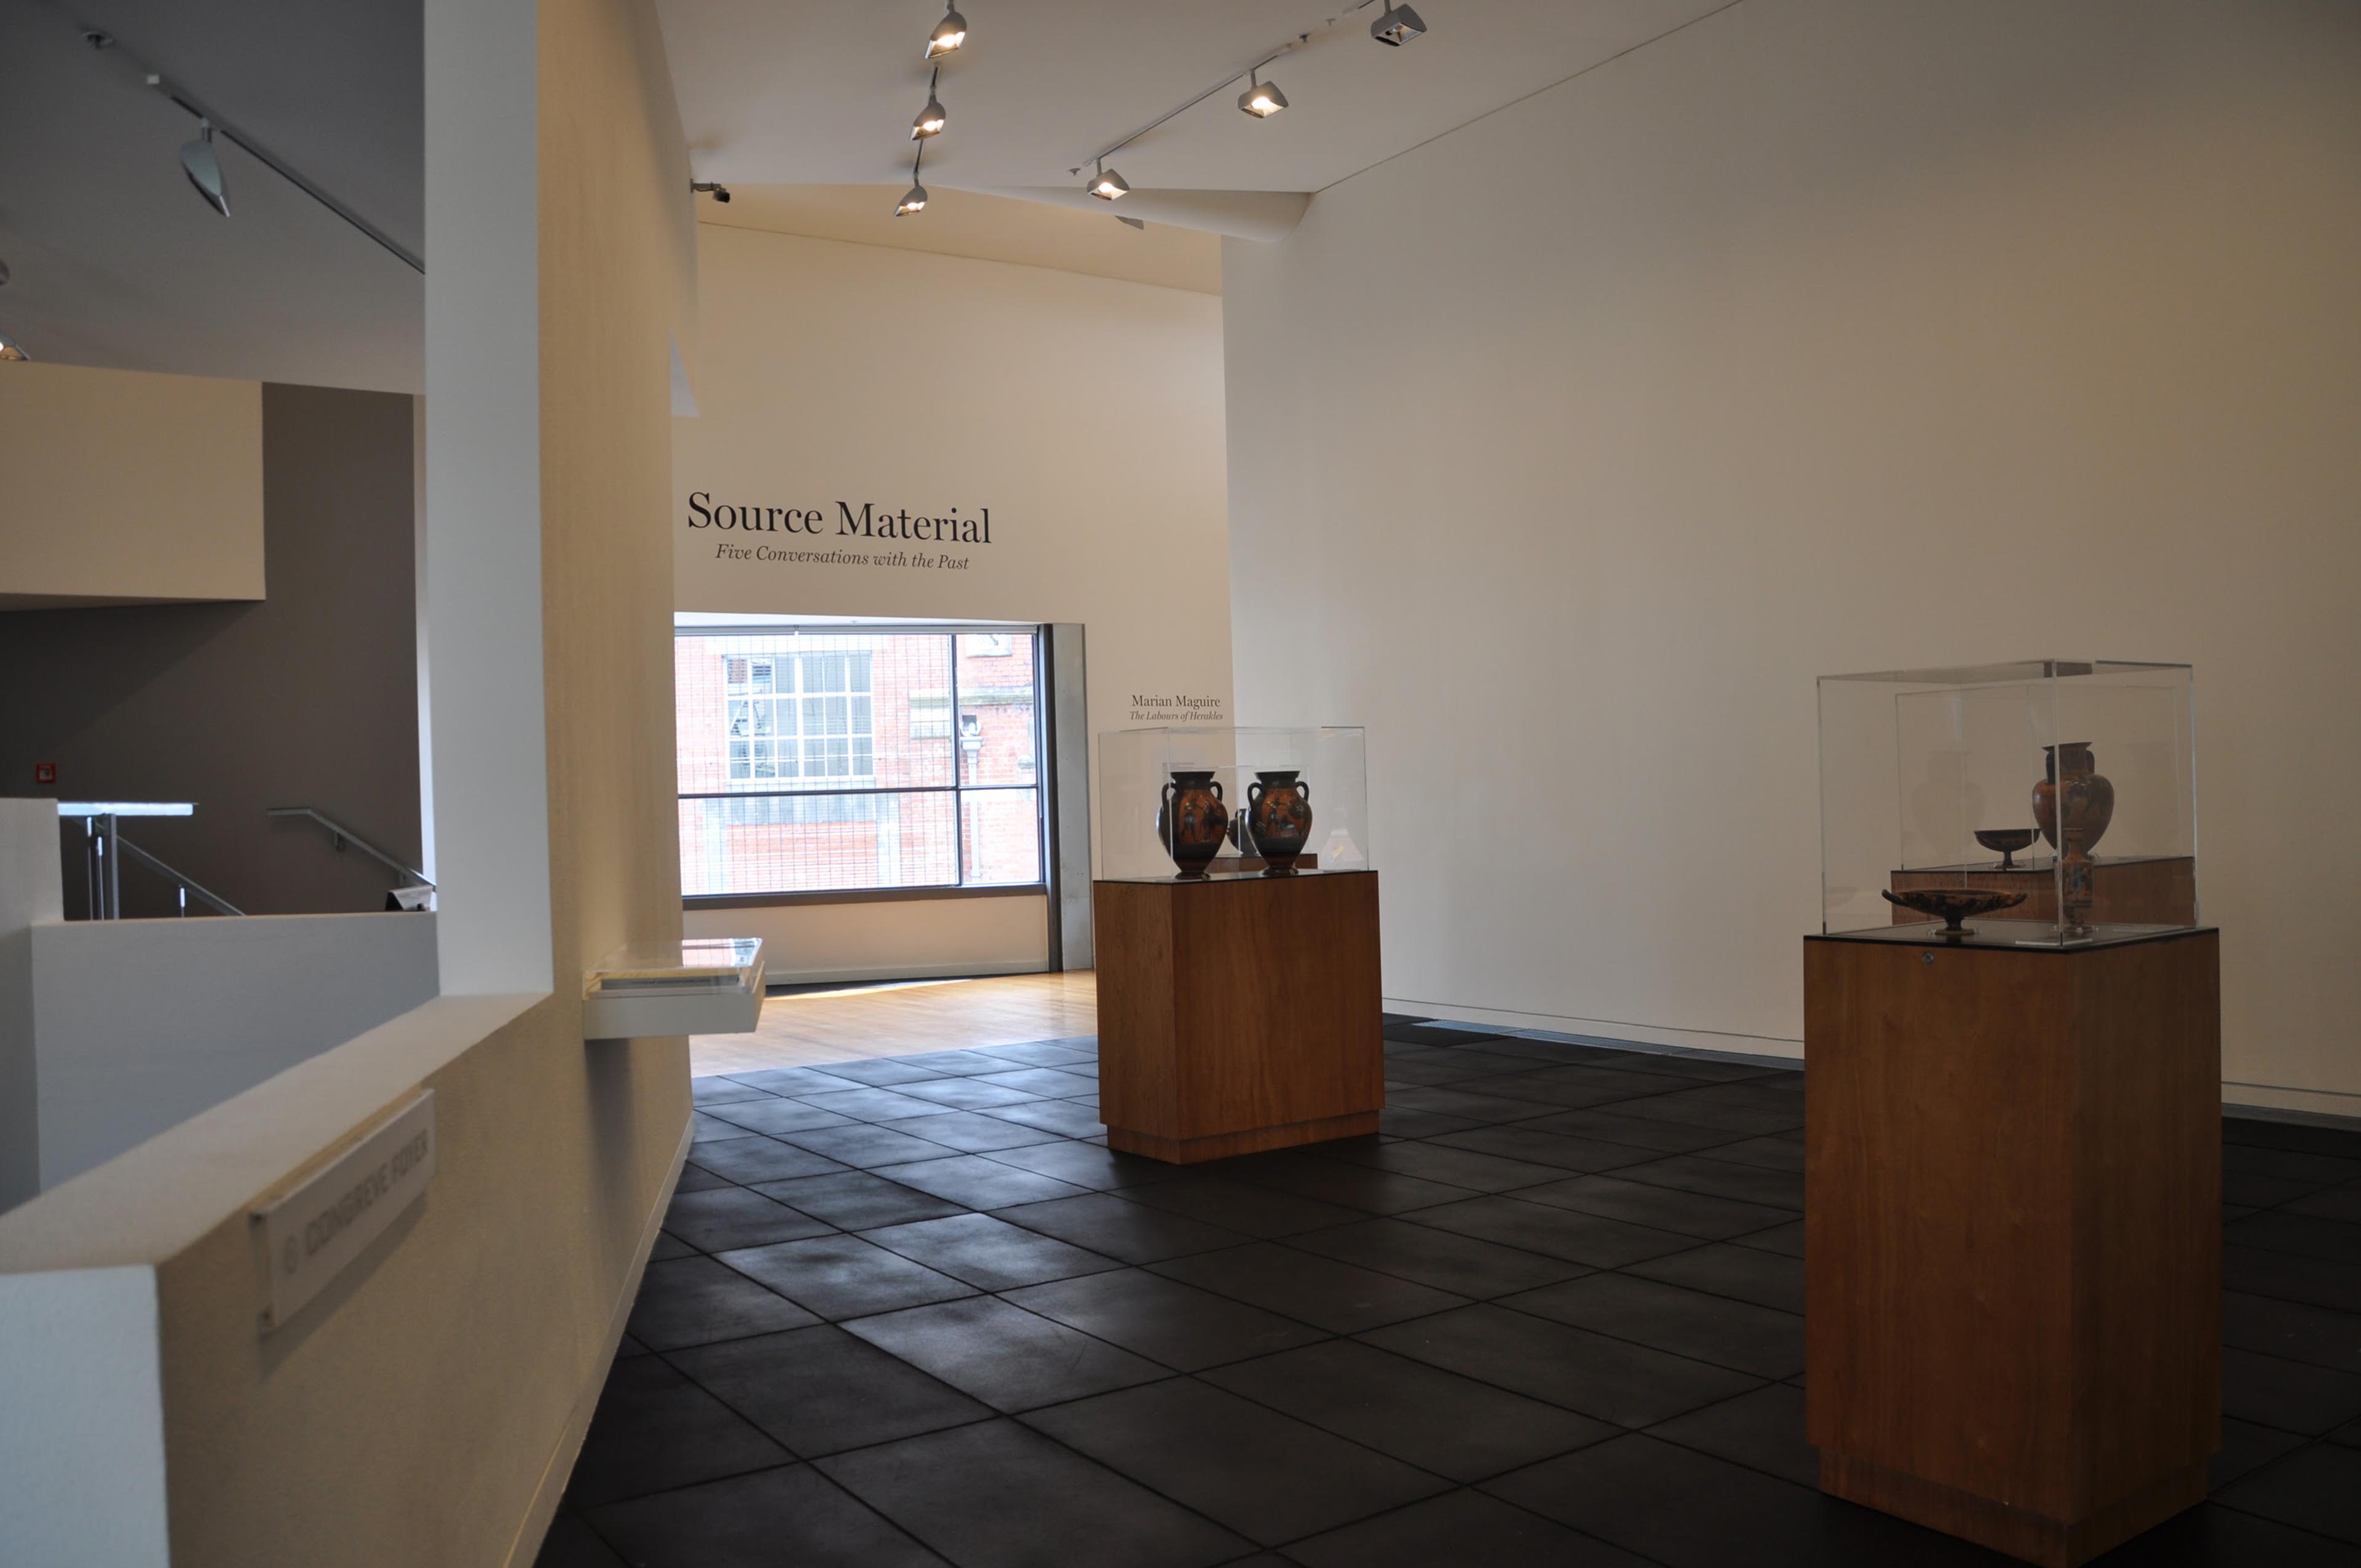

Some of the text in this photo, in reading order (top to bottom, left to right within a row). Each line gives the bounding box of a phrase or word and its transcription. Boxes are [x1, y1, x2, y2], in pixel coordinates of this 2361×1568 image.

[688, 491, 992, 544] Source Material
[715, 543, 970, 570] Five Conversations with the Past
[1132, 695, 1220, 710] Marian Maguire
[1129, 711, 1224, 722] The Labours of Herakles
